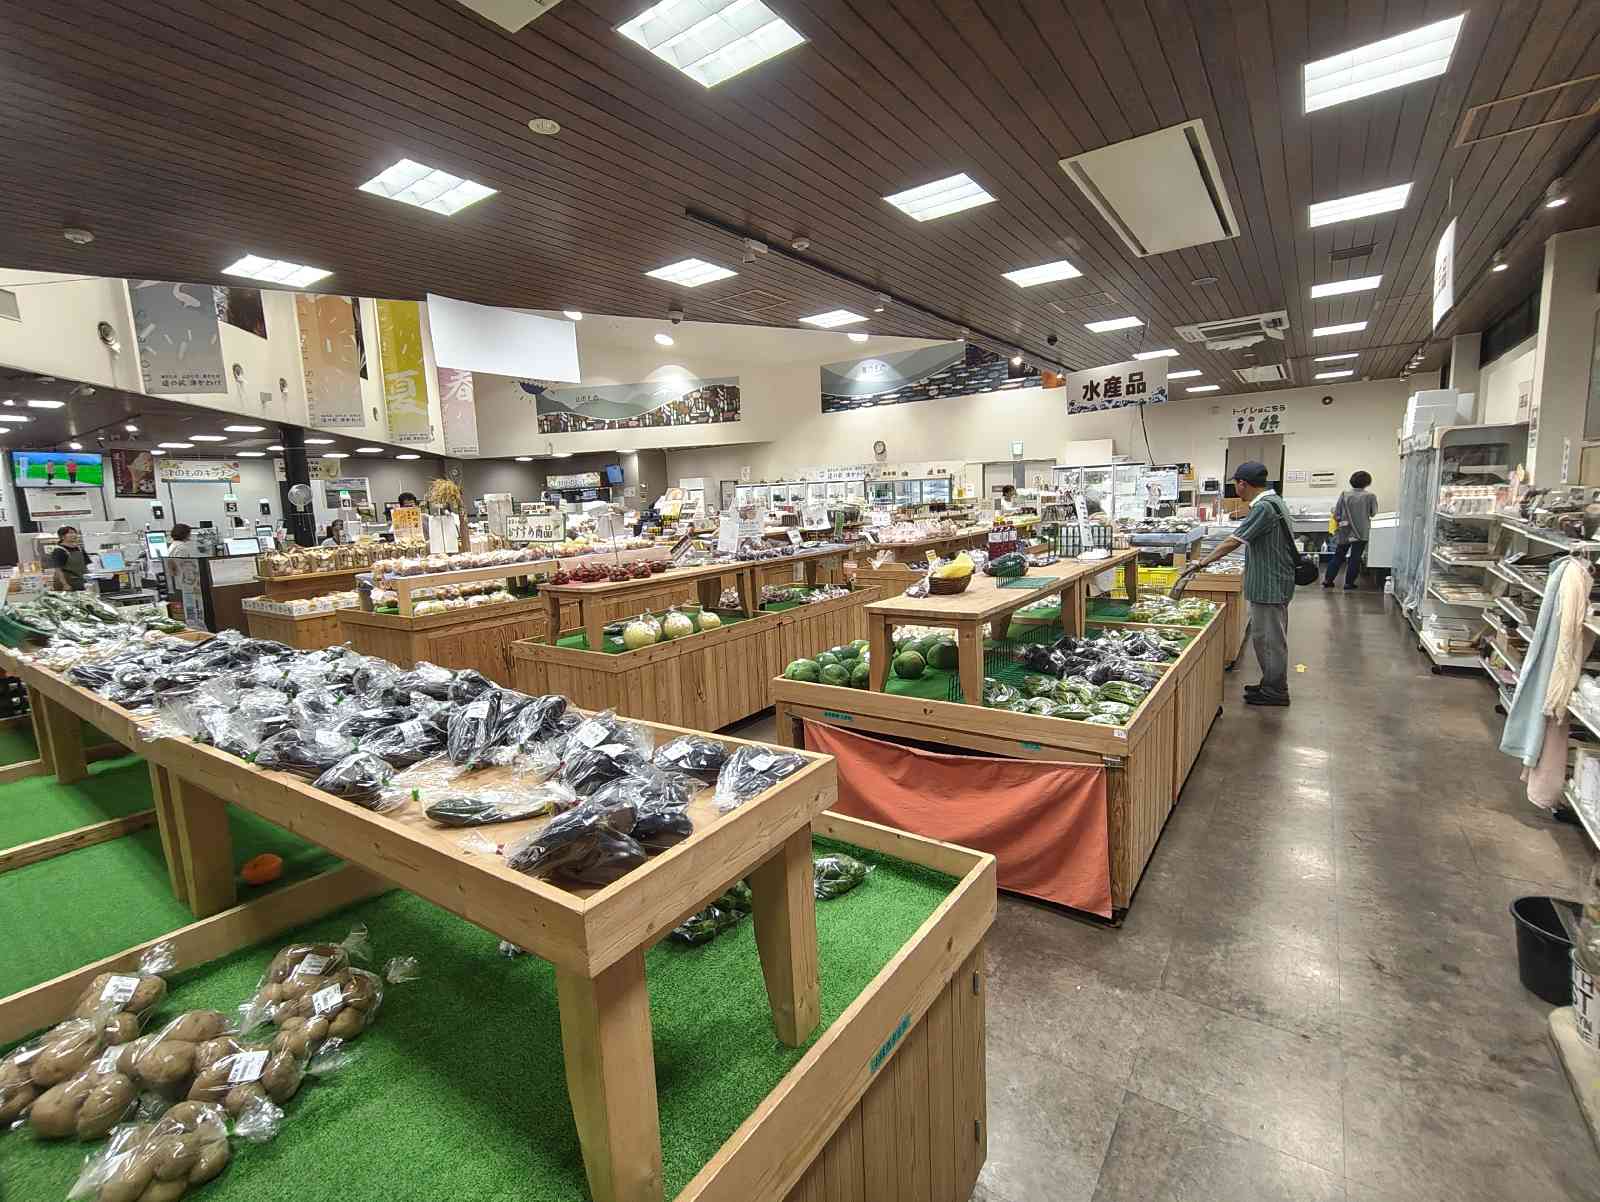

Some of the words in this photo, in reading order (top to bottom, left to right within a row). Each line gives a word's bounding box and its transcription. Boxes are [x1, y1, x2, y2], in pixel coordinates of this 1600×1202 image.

[385, 368, 428, 416] 夏
[1082, 371, 1147, 402] 水産品
[1232, 404, 1286, 415] トイレはこちら
